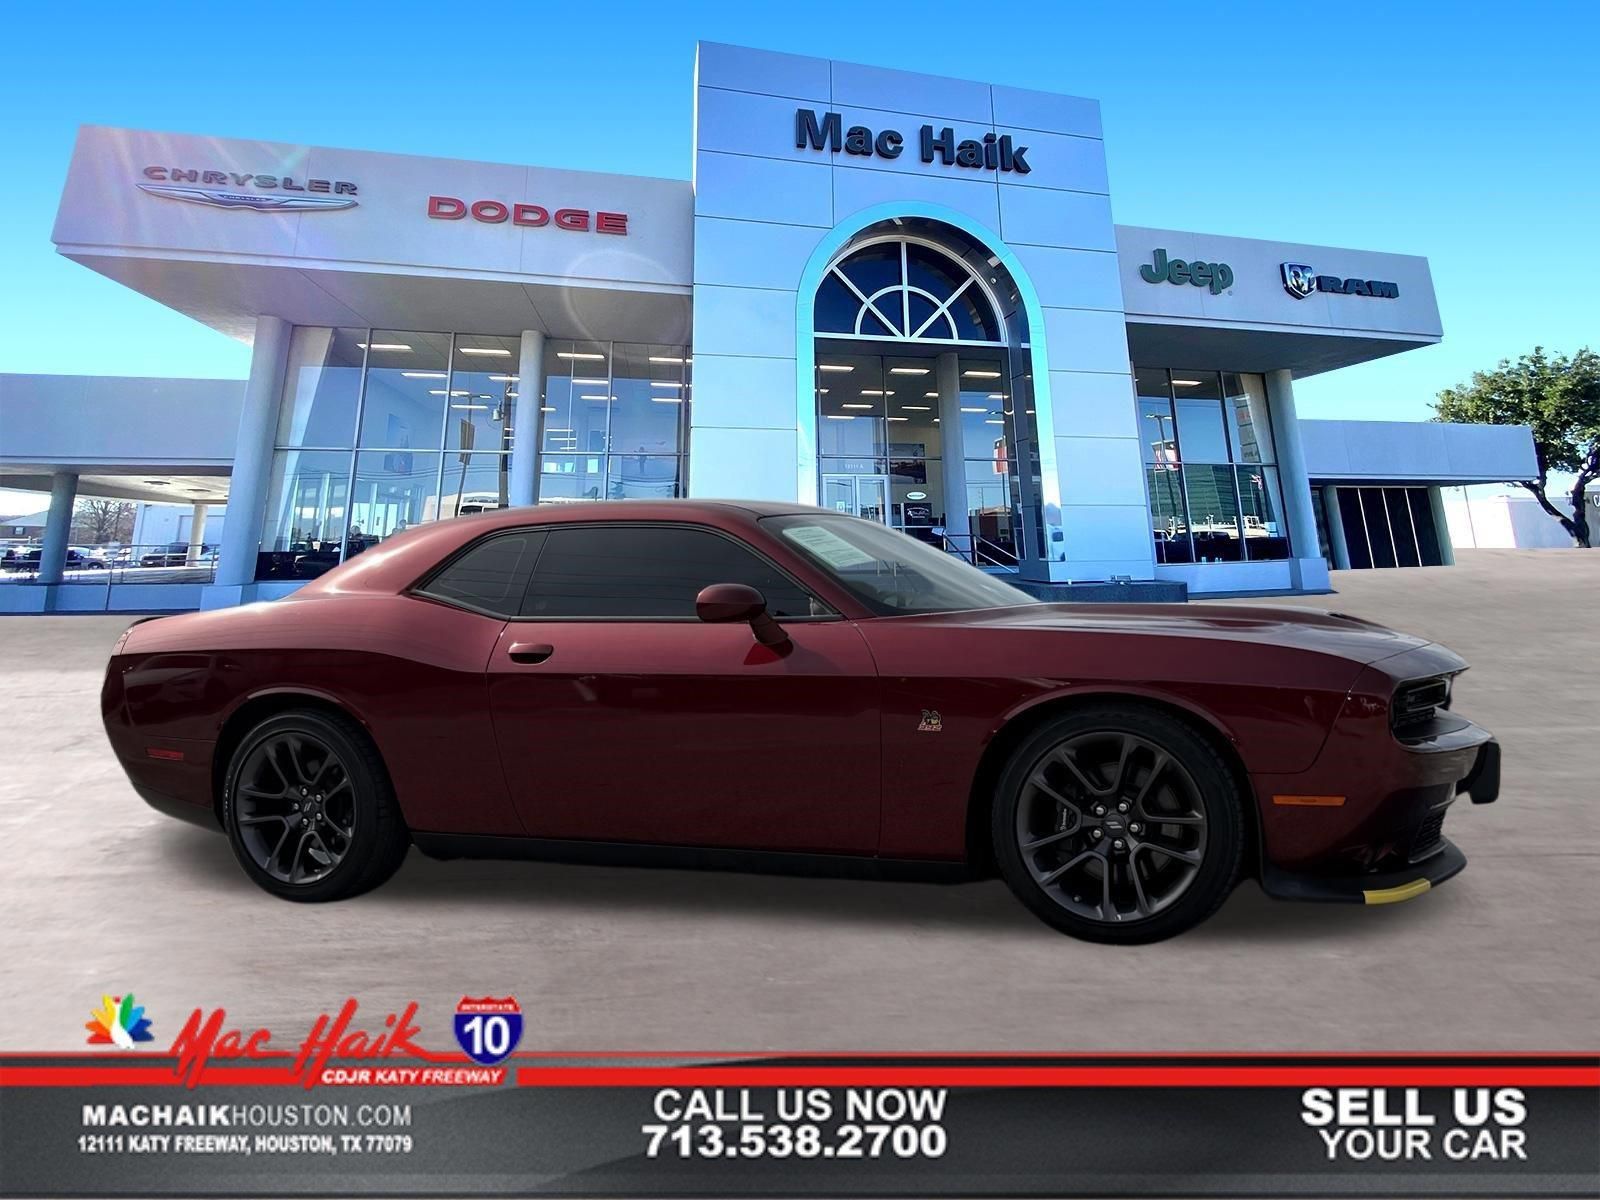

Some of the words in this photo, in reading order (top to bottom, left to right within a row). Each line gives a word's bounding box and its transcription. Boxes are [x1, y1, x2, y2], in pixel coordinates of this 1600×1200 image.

[795, 108, 904, 159] Mac
[920, 124, 1032, 174] Haik
[143, 166, 359, 196] CHRYSLER
[428, 196, 628, 236] DODGE
[1139, 248, 1234, 295] Jeep
[1315, 275, 1400, 299] RAM
